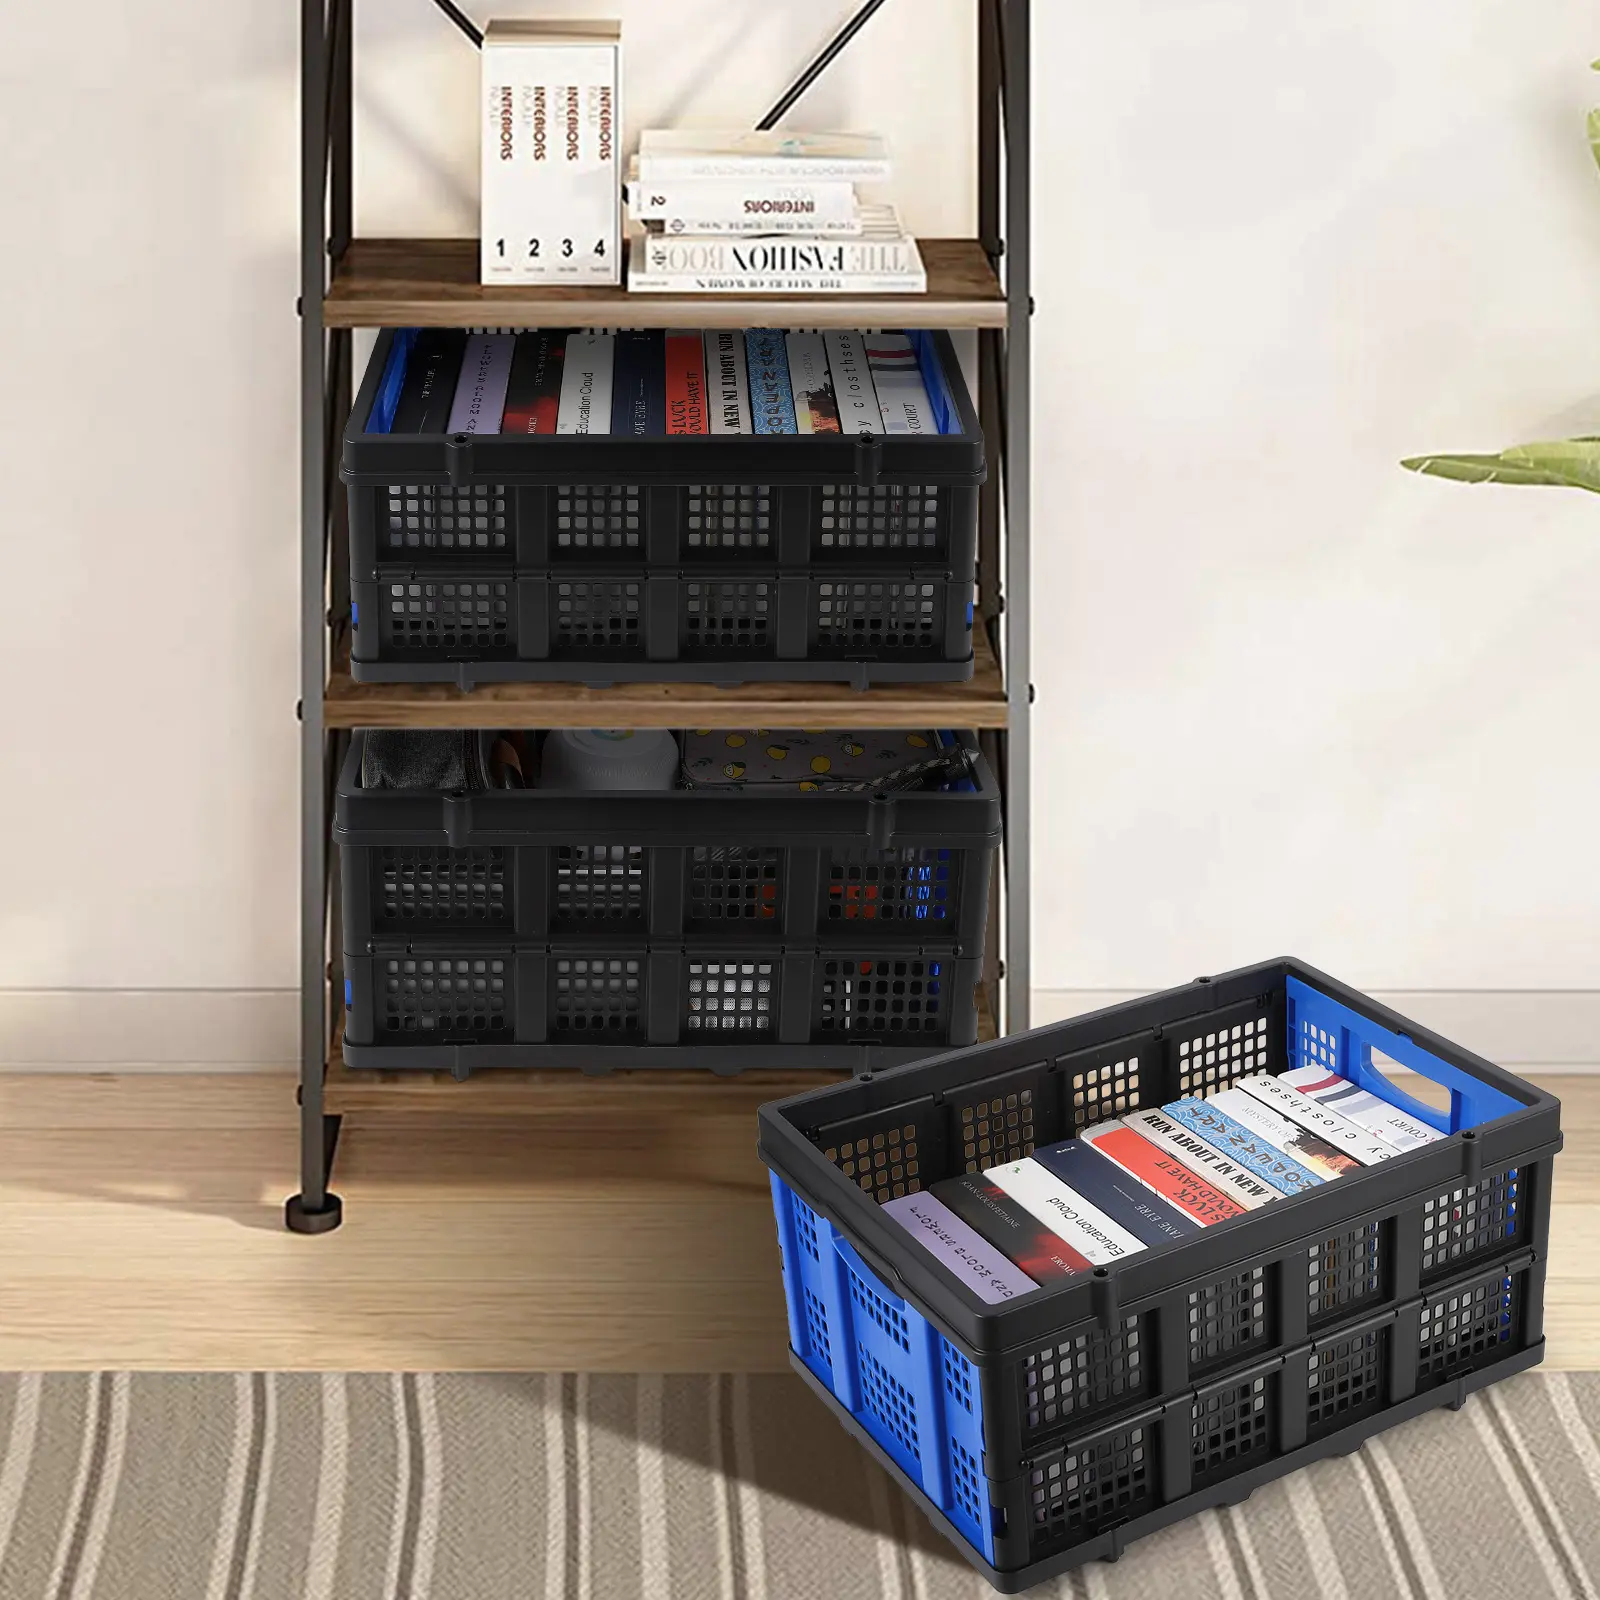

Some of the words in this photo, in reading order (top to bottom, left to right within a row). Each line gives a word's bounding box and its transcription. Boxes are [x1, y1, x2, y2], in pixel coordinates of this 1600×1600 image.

[500, 86, 513, 160] INTERIORS
[534, 86, 546, 160] INTERIORS
[566, 86, 579, 160] INTERIORS
[599, 86, 612, 160] INTERIORS
[744, 200, 815, 213] INTERIORS
[497, 238, 504, 257] 1
[529, 238, 540, 257] 2
[562, 238, 573, 258] 3
[594, 238, 605, 257] 4
[732, 246, 843, 271] FASHION
[719, 333, 734, 352] RUN
[720, 354, 736, 386] ABOUT
[580, 372, 594, 394] Cloud
[688, 381, 700, 406] HAVE
[723, 390, 738, 401] IN
[576, 395, 591, 434] Education
[724, 404, 740, 428] NEW
[1387, 1118, 1428, 1138] COURT
[1142, 1114, 1174, 1134] RUN
[1168, 1133, 1220, 1164] ABOUT
[1213, 1162, 1238, 1176] IN
[1230, 1174, 1269, 1198] NEW
[1154, 1160, 1173, 1170] IT
[1167, 1167, 1200, 1191] HAVE
[1046, 1196, 1080, 1220] Cloud
[1134, 1203, 1161, 1223] EYRE
[1076, 1214, 1125, 1257] Education
[909, 1206, 956, 1248] FLOWERS
[954, 1247, 993, 1278] BLOOM
[990, 1278, 1014, 1298] AND
